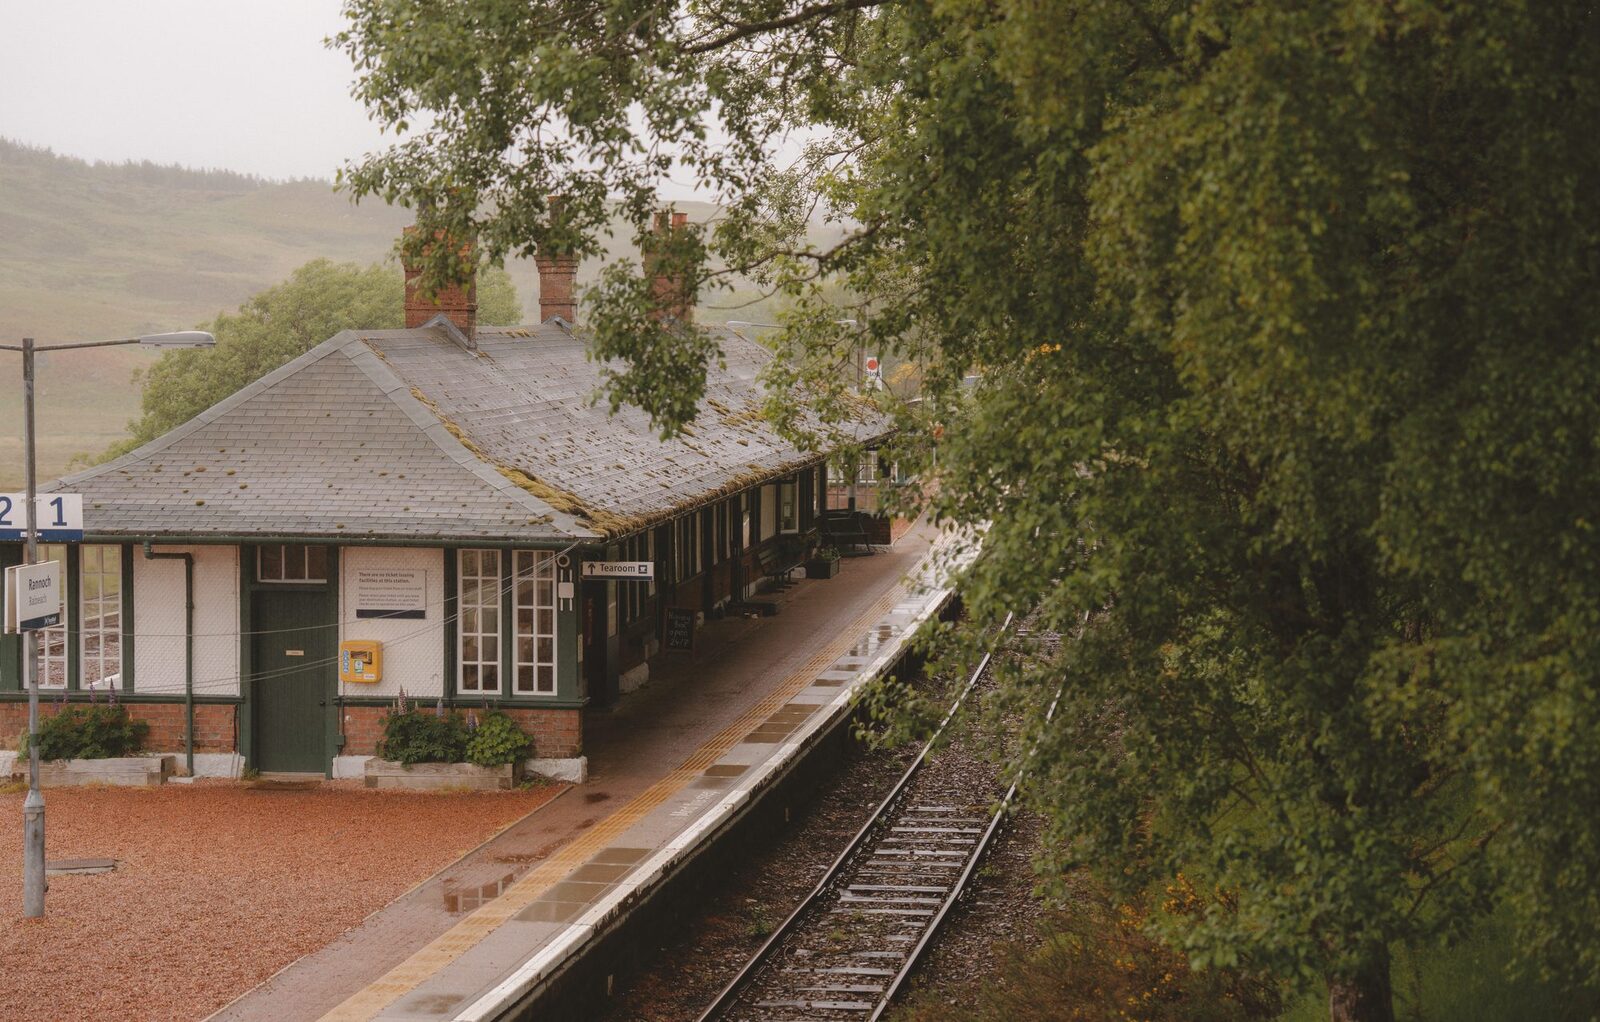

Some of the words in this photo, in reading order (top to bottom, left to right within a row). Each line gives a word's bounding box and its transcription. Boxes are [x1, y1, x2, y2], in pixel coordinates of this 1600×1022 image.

[0, 496, 12, 526] 2
[50, 497, 67, 526] 1
[600, 563, 636, 573] Tearoom
[28, 575, 52, 592] Rannoch
